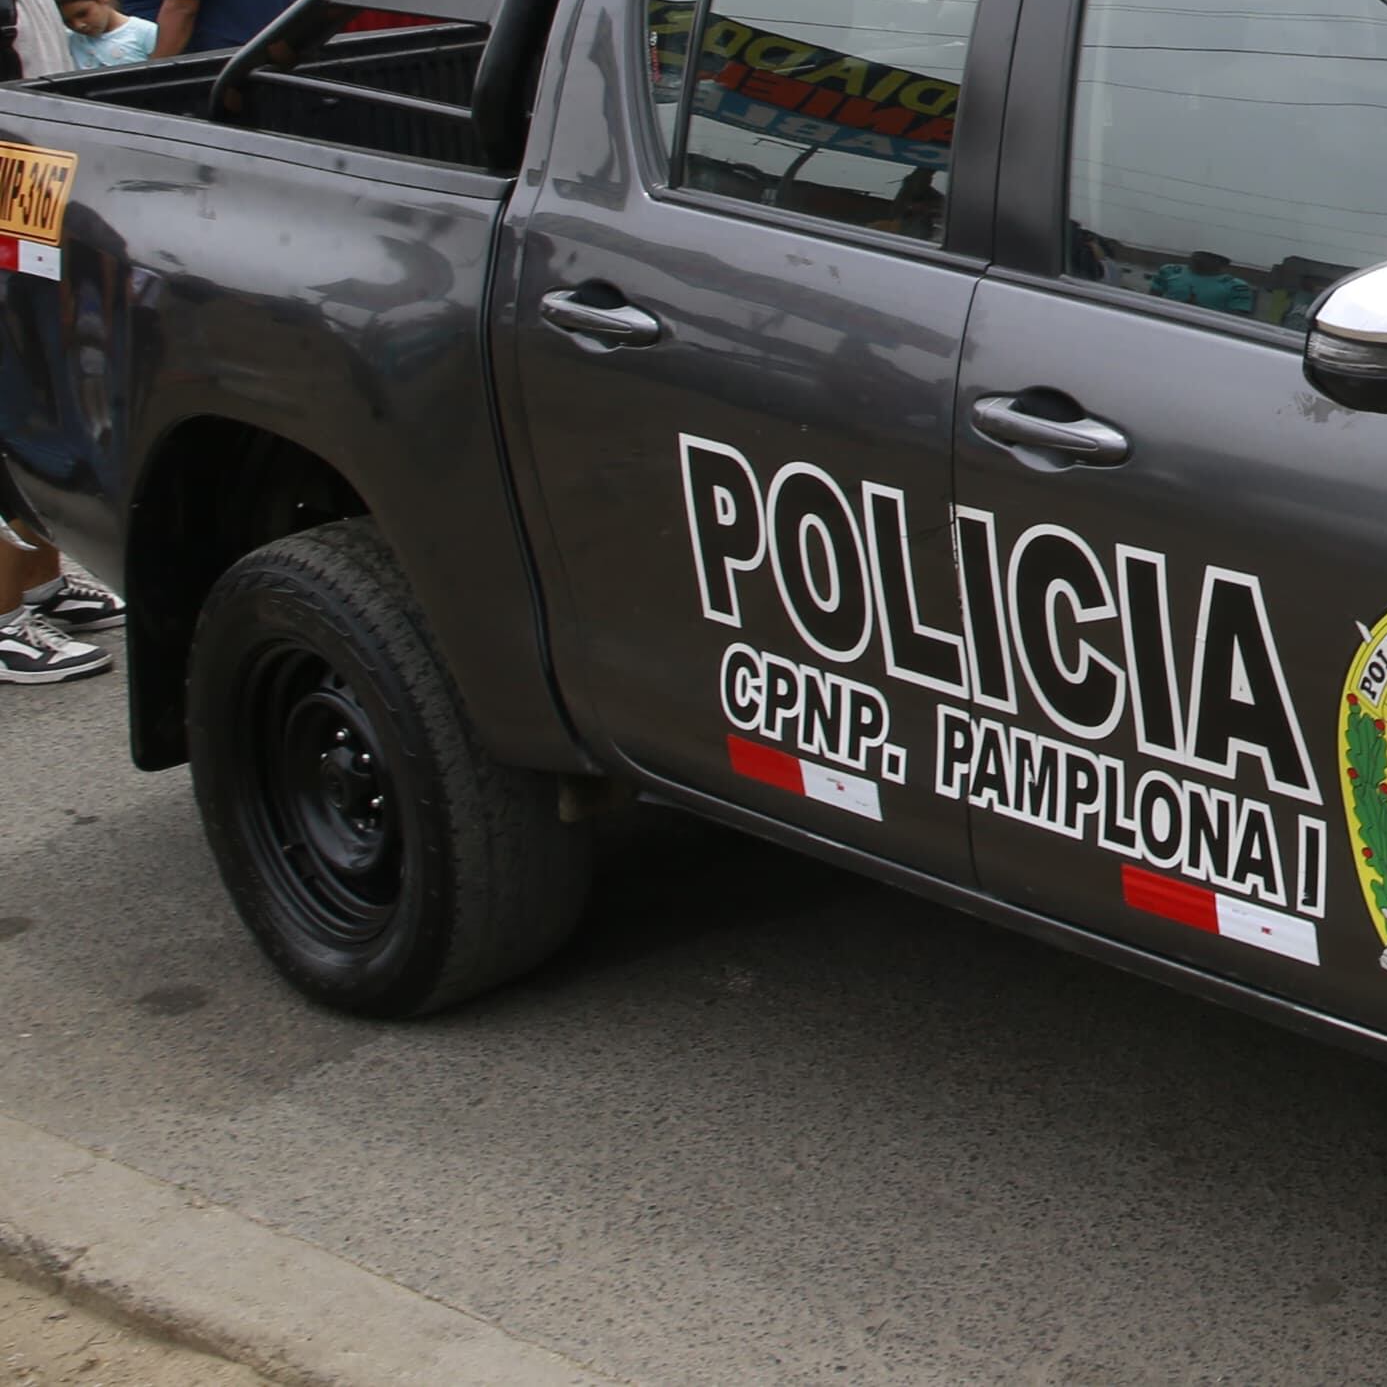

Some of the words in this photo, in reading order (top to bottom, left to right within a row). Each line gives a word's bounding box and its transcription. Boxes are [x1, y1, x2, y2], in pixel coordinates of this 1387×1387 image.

[678, 432, 1324, 806] POLICIA
[720, 642, 906, 785] CPNP.
[935, 704, 1287, 906] PAMPLONA
